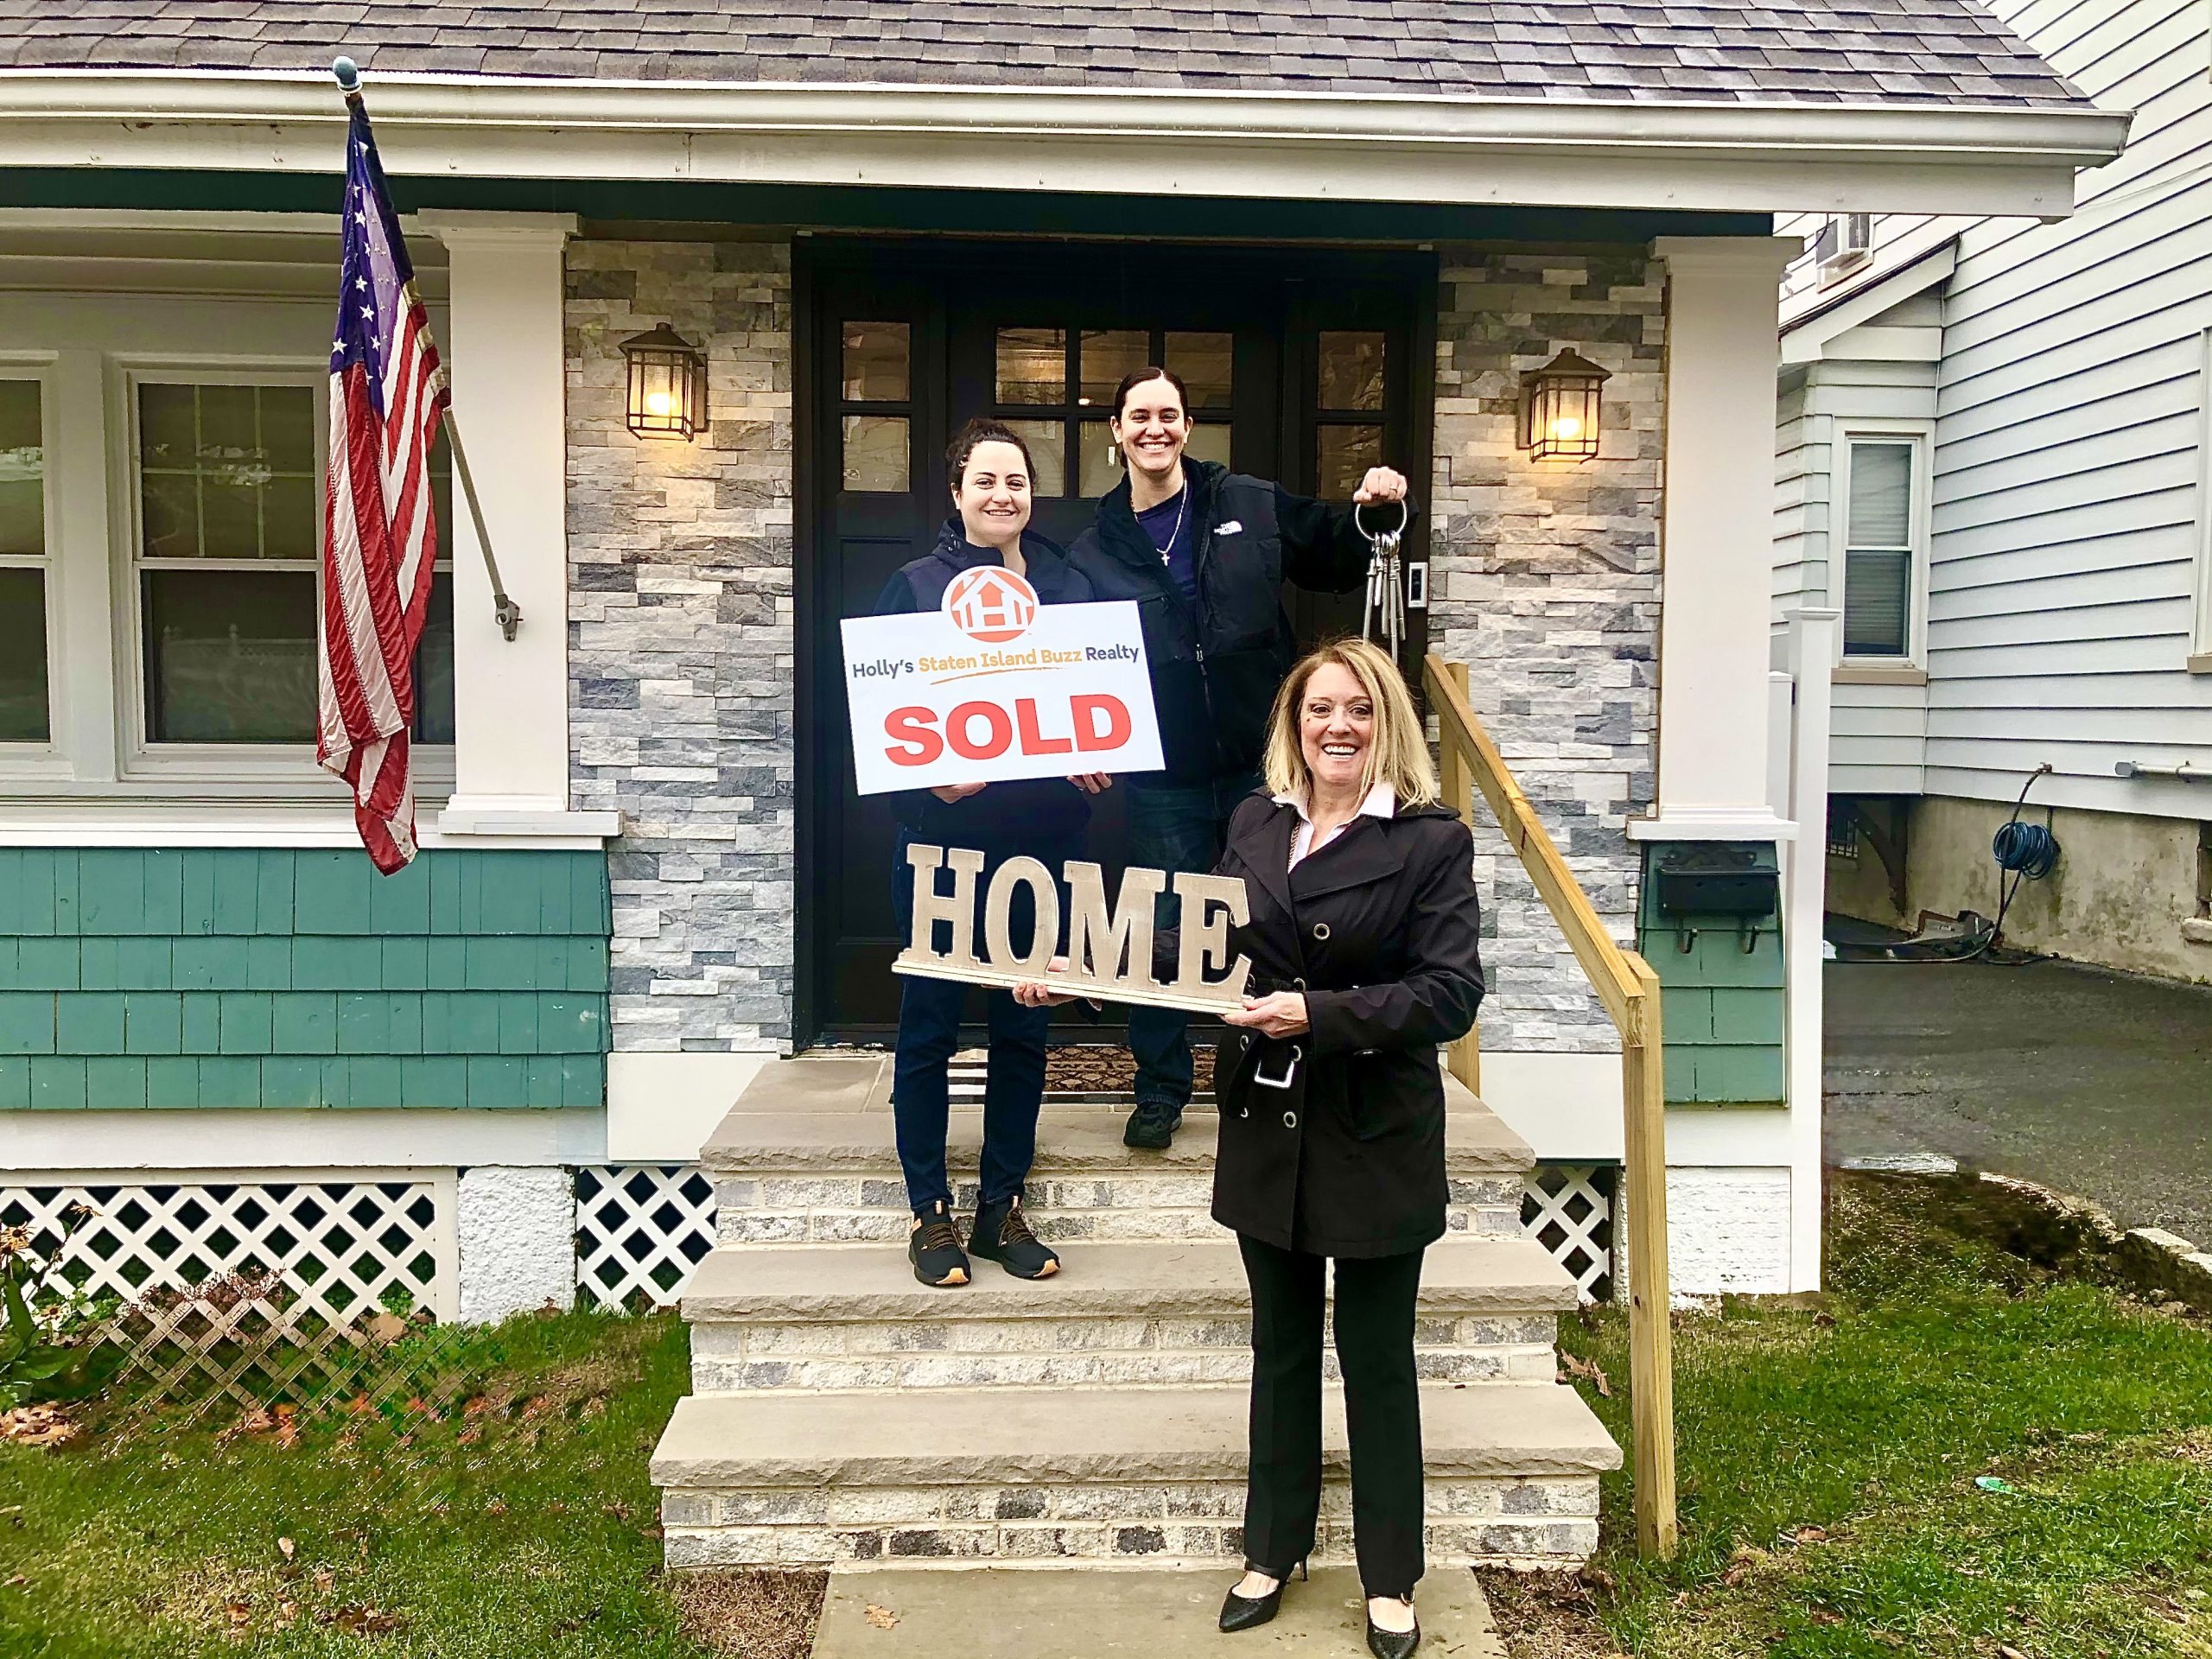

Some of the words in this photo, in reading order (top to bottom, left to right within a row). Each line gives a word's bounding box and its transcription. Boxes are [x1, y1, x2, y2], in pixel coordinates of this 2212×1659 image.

[853, 659, 914, 679] Holly's
[918, 656, 977, 672] Staten
[980, 649, 1037, 667] Island
[1040, 649, 1082, 664] Buzz
[1085, 644, 1140, 664] Realty
[884, 694, 1132, 766] SOLD
[899, 843, 1252, 1004] HOME
